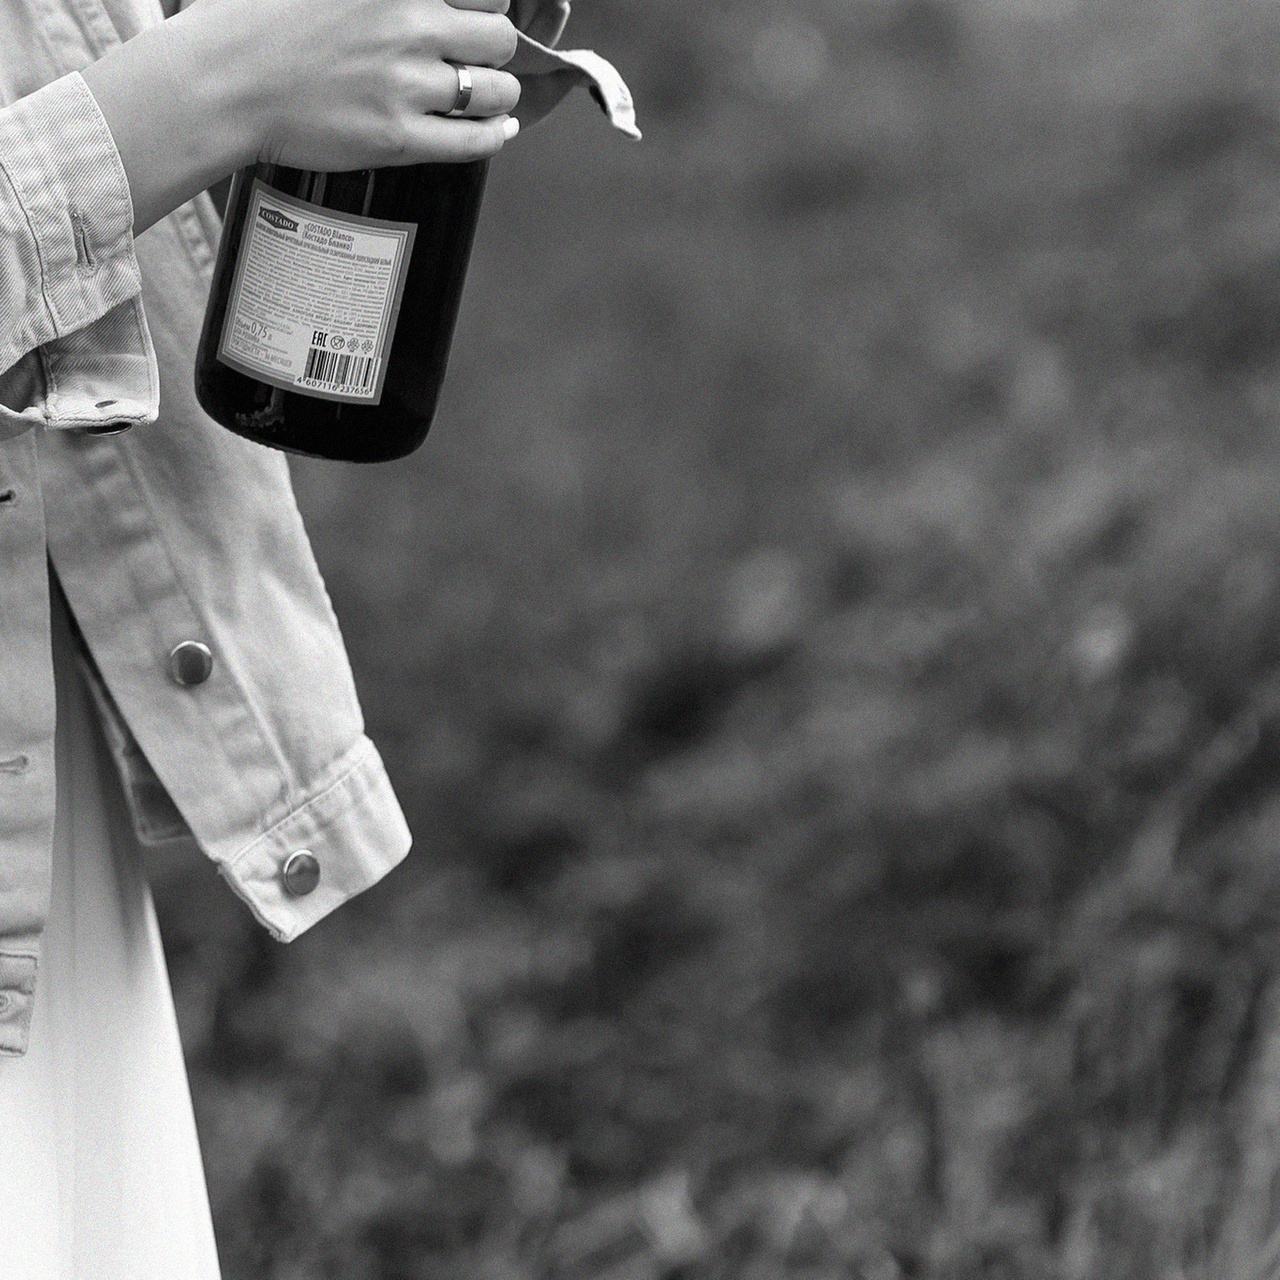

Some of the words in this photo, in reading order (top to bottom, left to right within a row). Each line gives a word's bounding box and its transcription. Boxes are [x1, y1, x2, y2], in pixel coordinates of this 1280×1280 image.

[261, 210, 294, 229] COSTADO
[251, 321, 267, 339] 0,75
[305, 379, 338, 391] 607116
[340, 385, 370, 395] 237656
